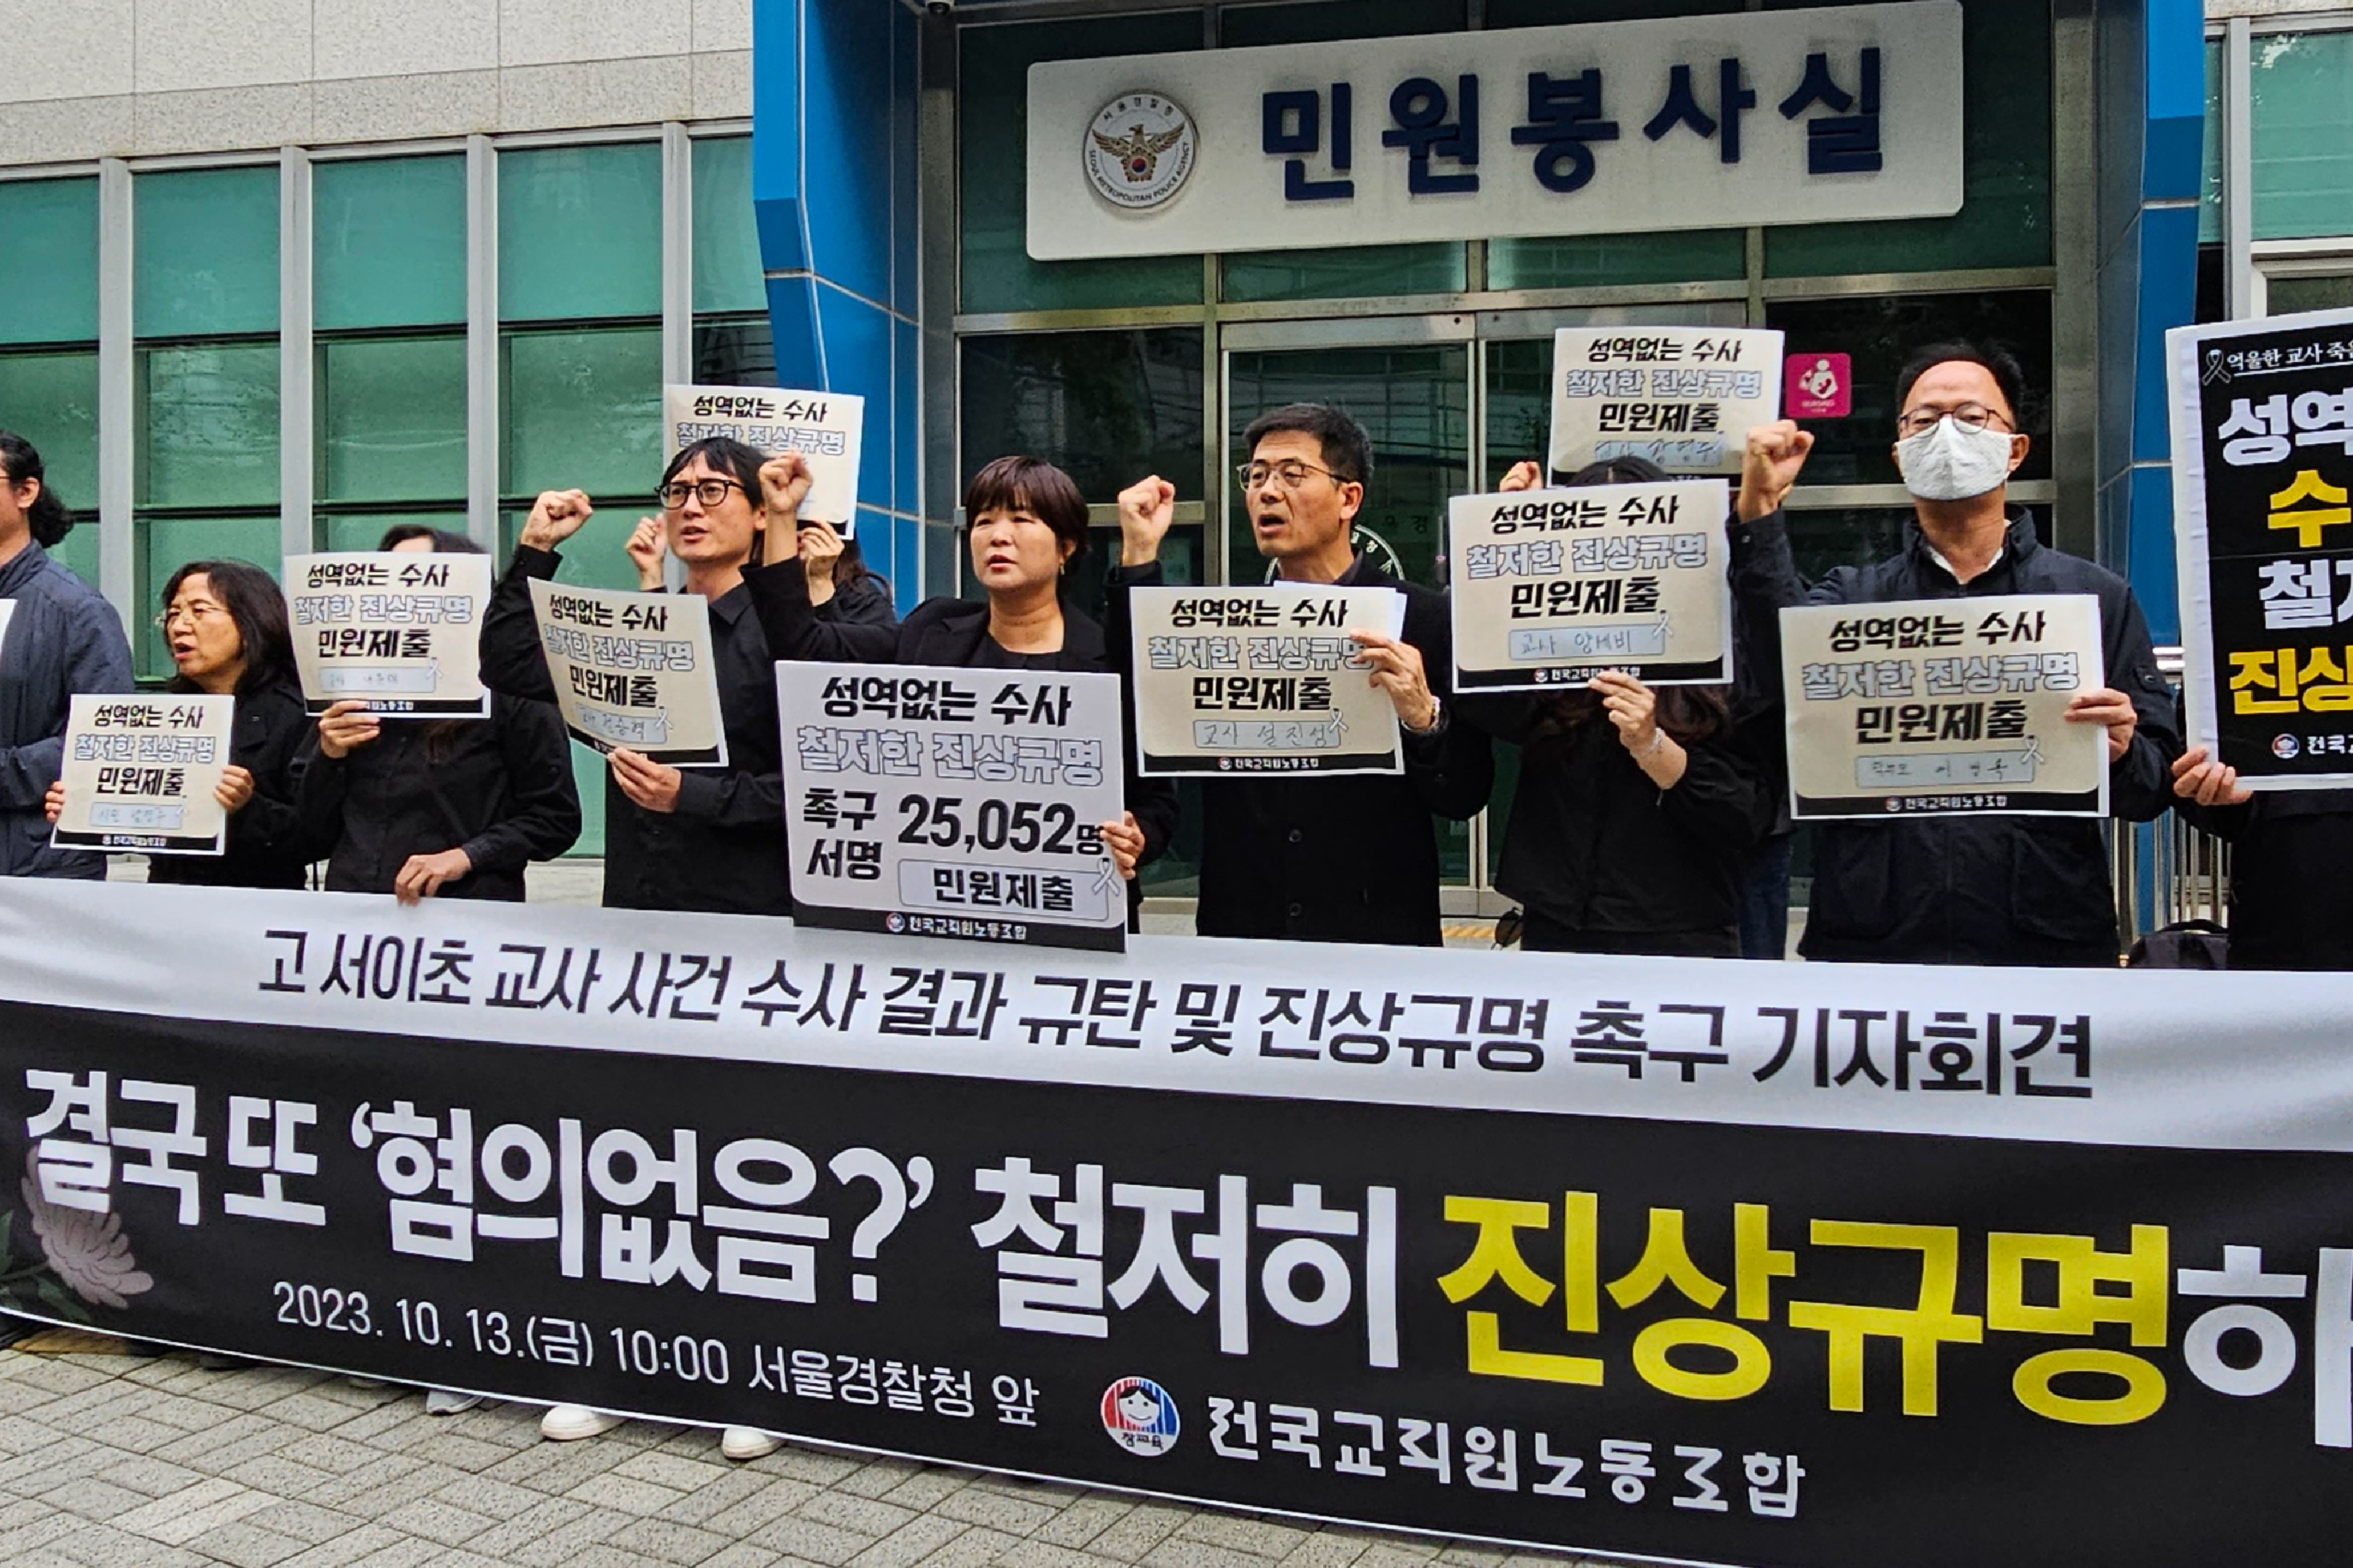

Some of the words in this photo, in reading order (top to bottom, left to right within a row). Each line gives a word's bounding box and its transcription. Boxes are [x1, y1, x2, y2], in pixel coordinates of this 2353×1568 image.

[1262, 47, 1882, 202] 민원봉사실
[1588, 337, 1684, 362] 성역없는
[1692, 339, 1742, 362] 수사
[2227, 349, 2282, 370] 억울한
[2285, 343, 2324, 365] 교사
[1567, 369, 1644, 397] 철저한
[1652, 370, 1762, 398] 진상규명
[693, 395, 776, 419] 성역없는
[782, 400, 828, 423] 수사
[1599, 403, 1720, 432] 민원제출
[748, 425, 846, 455] 진상규명
[1491, 499, 1606, 535] 성역없는
[1618, 495, 1679, 526] 수사
[308, 563, 389, 588] 성역없는
[398, 564, 450, 587] 수사
[1467, 540, 1564, 580] 철저한
[1572, 532, 1708, 572] 진상규명
[294, 595, 354, 625] 철저한
[360, 595, 473, 623] 진상규명
[550, 594, 614, 628] 성역없는
[622, 604, 668, 632] 수사
[1171, 598, 1280, 628] 성역없는
[1290, 598, 1349, 628] 수사
[1511, 576, 1660, 619] 민원제출
[319, 629, 431, 658] 민원제출
[544, 623, 590, 663] 철저한
[593, 635, 695, 671] 진상규명
[1830, 615, 1964, 652] 성역없는
[1977, 610, 2046, 645] 수사
[1148, 636, 1241, 670] 철저한
[569, 665, 657, 708] 민원제출
[1192, 676, 1331, 711] 민원제출
[1803, 660, 1916, 700] 철저한
[1924, 652, 2080, 696] 진상규명
[95, 705, 163, 727] 성역없는
[168, 705, 203, 729] 수사
[821, 676, 977, 721] 성역없는
[991, 683, 1071, 726] 수사
[1856, 699, 2027, 744] 민원제출
[75, 733, 135, 762] 철저한
[139, 734, 215, 764] 진상규명
[797, 726, 922, 777] 철저한
[933, 732, 1103, 787] 진상규명
[96, 767, 184, 796] 민원제출
[803, 787, 878, 830] 촉구
[898, 794, 1105, 855] 25,052명
[806, 839, 882, 880] 서명
[933, 867, 1074, 912] 민원제출
[258, 930, 308, 993] 고
[320, 933, 474, 1005] 서이초
[486, 943, 602, 1014] 교사
[608, 951, 732, 1021] 사건
[741, 960, 866, 1032] 수사
[879, 967, 1007, 1040] 결과
[1019, 976, 1157, 1049] 규탄
[1171, 983, 1241, 1056] 및
[1258, 988, 1549, 1072] 진상규명
[1571, 1000, 1729, 1082] 촉구
[1752, 1006, 2092, 1098] 기자회견
[26, 1069, 207, 1225] 결국
[224, 1095, 326, 1226] 또
[971, 1157, 1399, 1369] 철저히
[273, 1281, 383, 1337] 2023.
[396, 1299, 453, 1347] 10.
[466, 1308, 593, 1366] 13.(금)
[611, 1327, 730, 1384] 10:00
[748, 1345, 974, 1419] 서울경찰청
[992, 1374, 1039, 1427] 앞
[1207, 1396, 1806, 1518] 전국교직원노동조합
